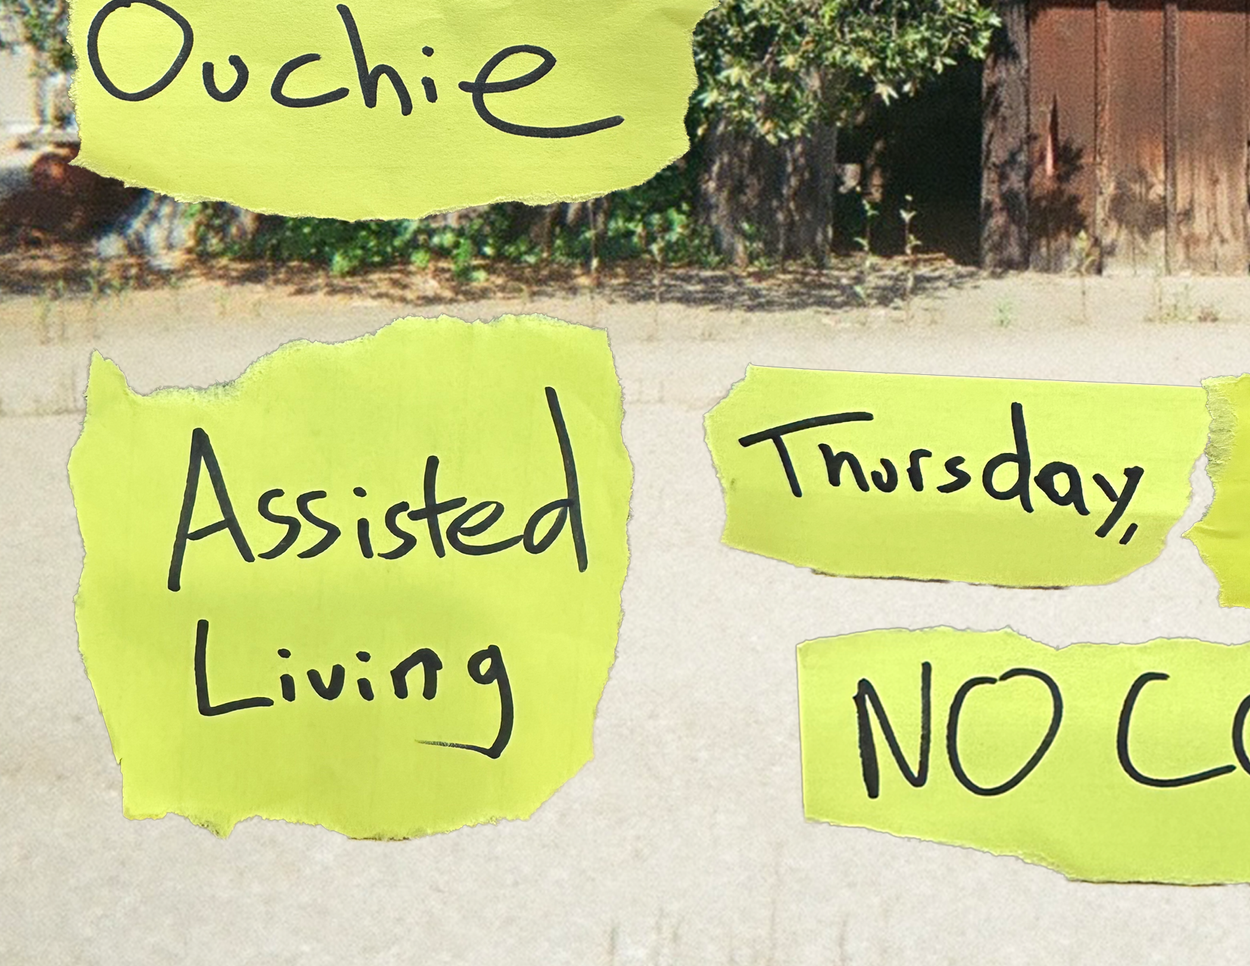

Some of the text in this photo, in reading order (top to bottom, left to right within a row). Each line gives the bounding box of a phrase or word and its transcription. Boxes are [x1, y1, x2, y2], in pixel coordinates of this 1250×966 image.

[167, 386, 588, 593] Assisted
[738, 402, 1146, 546] Thursday,
[194, 619, 516, 760] Living
[852, 661, 1063, 799] NO
